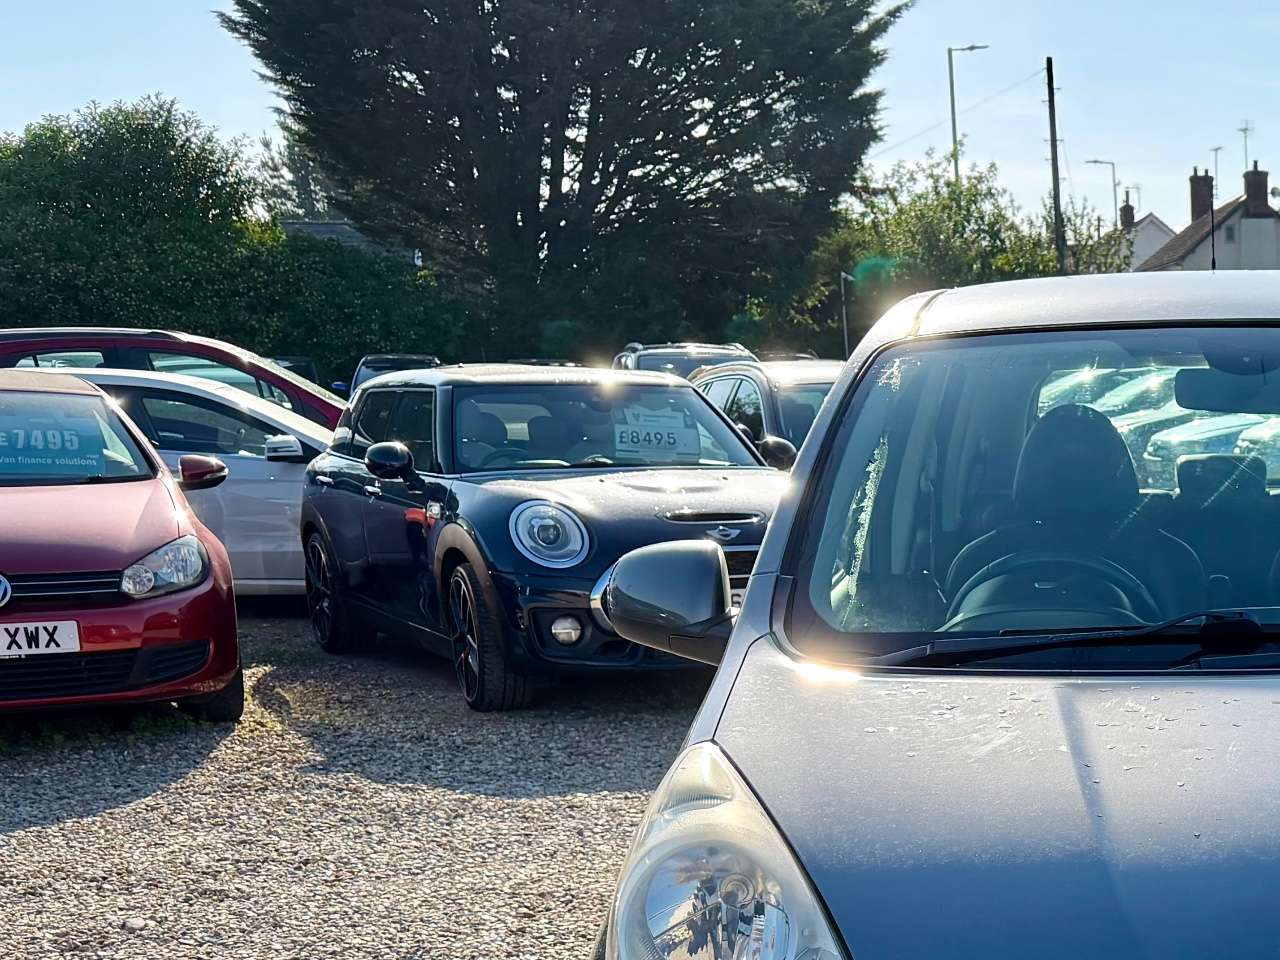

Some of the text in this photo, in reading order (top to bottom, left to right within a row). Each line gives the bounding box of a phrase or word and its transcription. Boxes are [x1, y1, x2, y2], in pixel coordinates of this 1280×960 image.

[618, 430, 677, 446] £8495
[18, 456, 52, 465] finance
[55, 457, 97, 466] solutions
[3, 625, 61, 650] XWX
